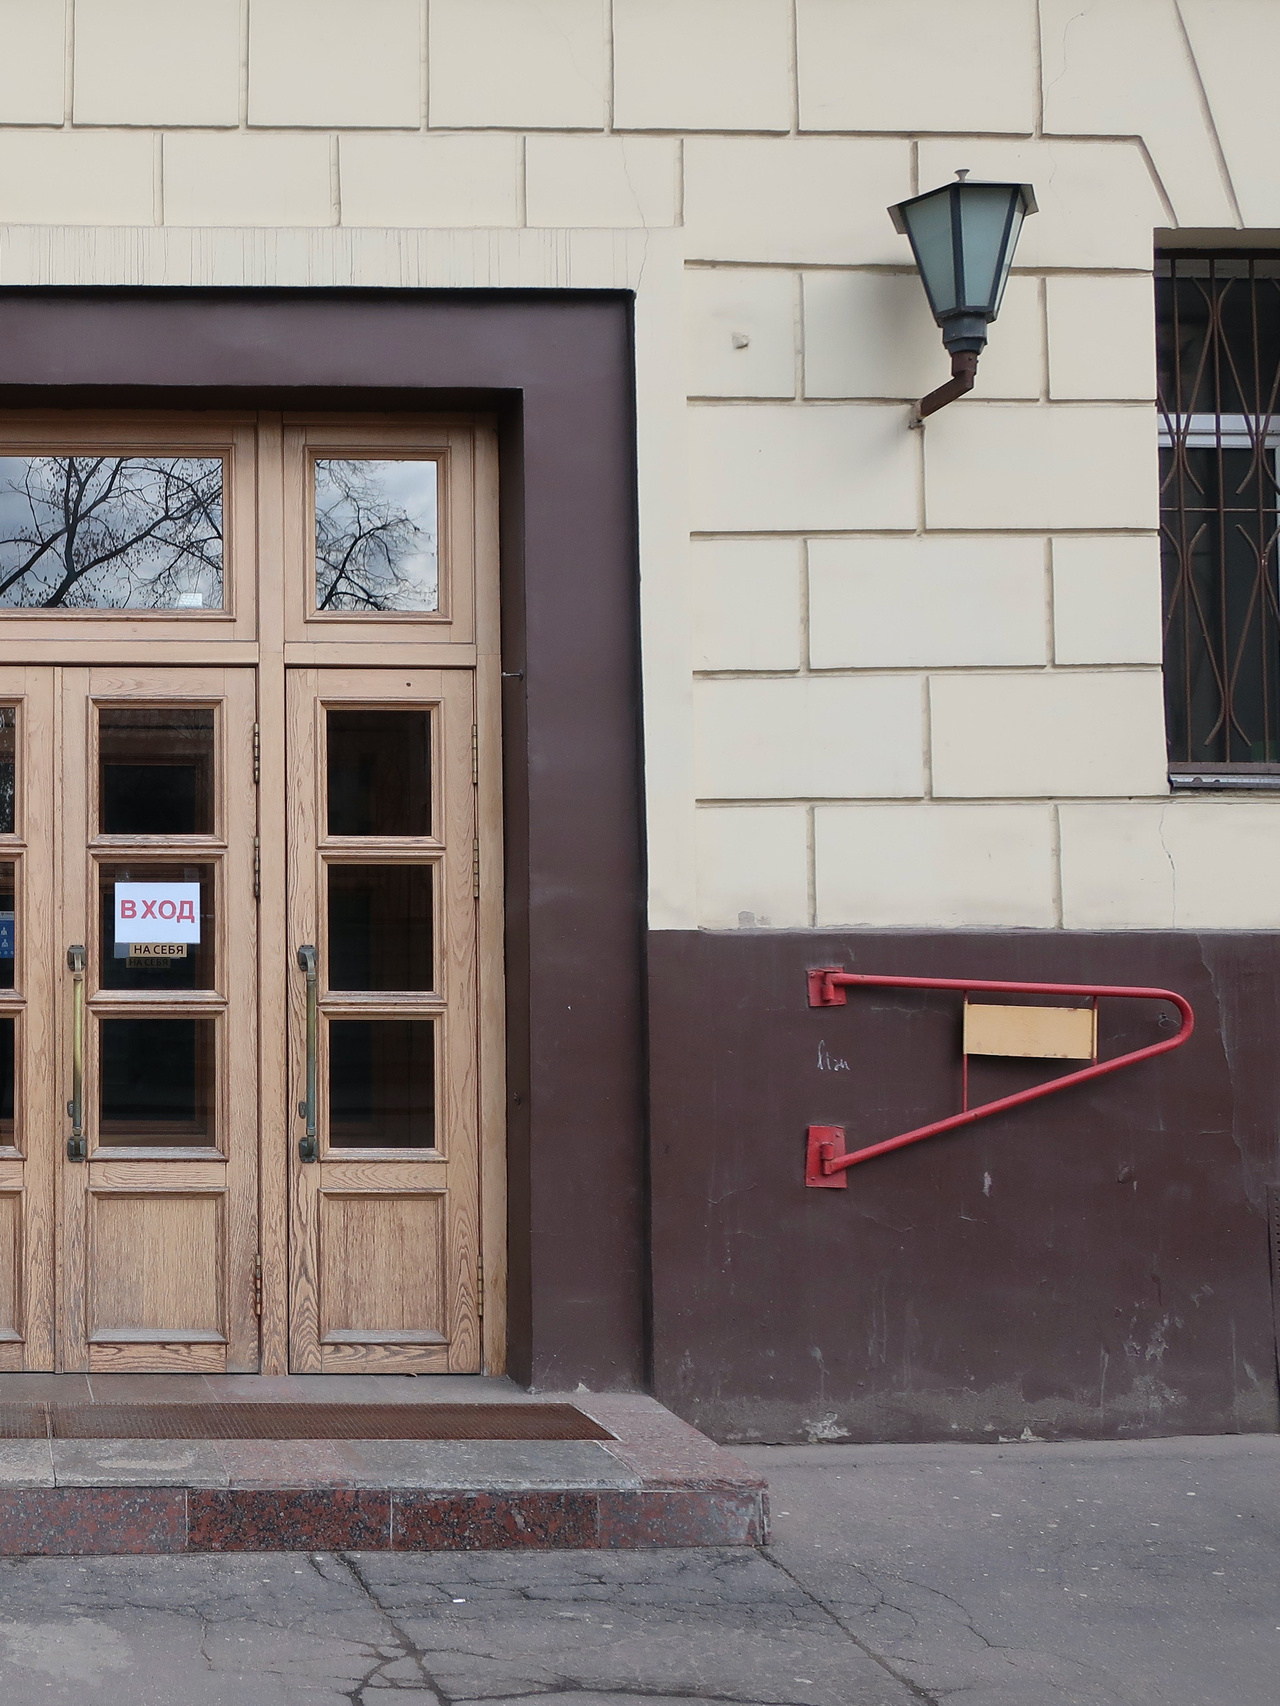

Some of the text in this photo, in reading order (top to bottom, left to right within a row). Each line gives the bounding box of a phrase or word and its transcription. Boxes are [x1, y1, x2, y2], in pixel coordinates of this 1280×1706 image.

[121, 900, 195, 923] ВХОД
[134, 945, 183, 954] НА СЕБЯ
